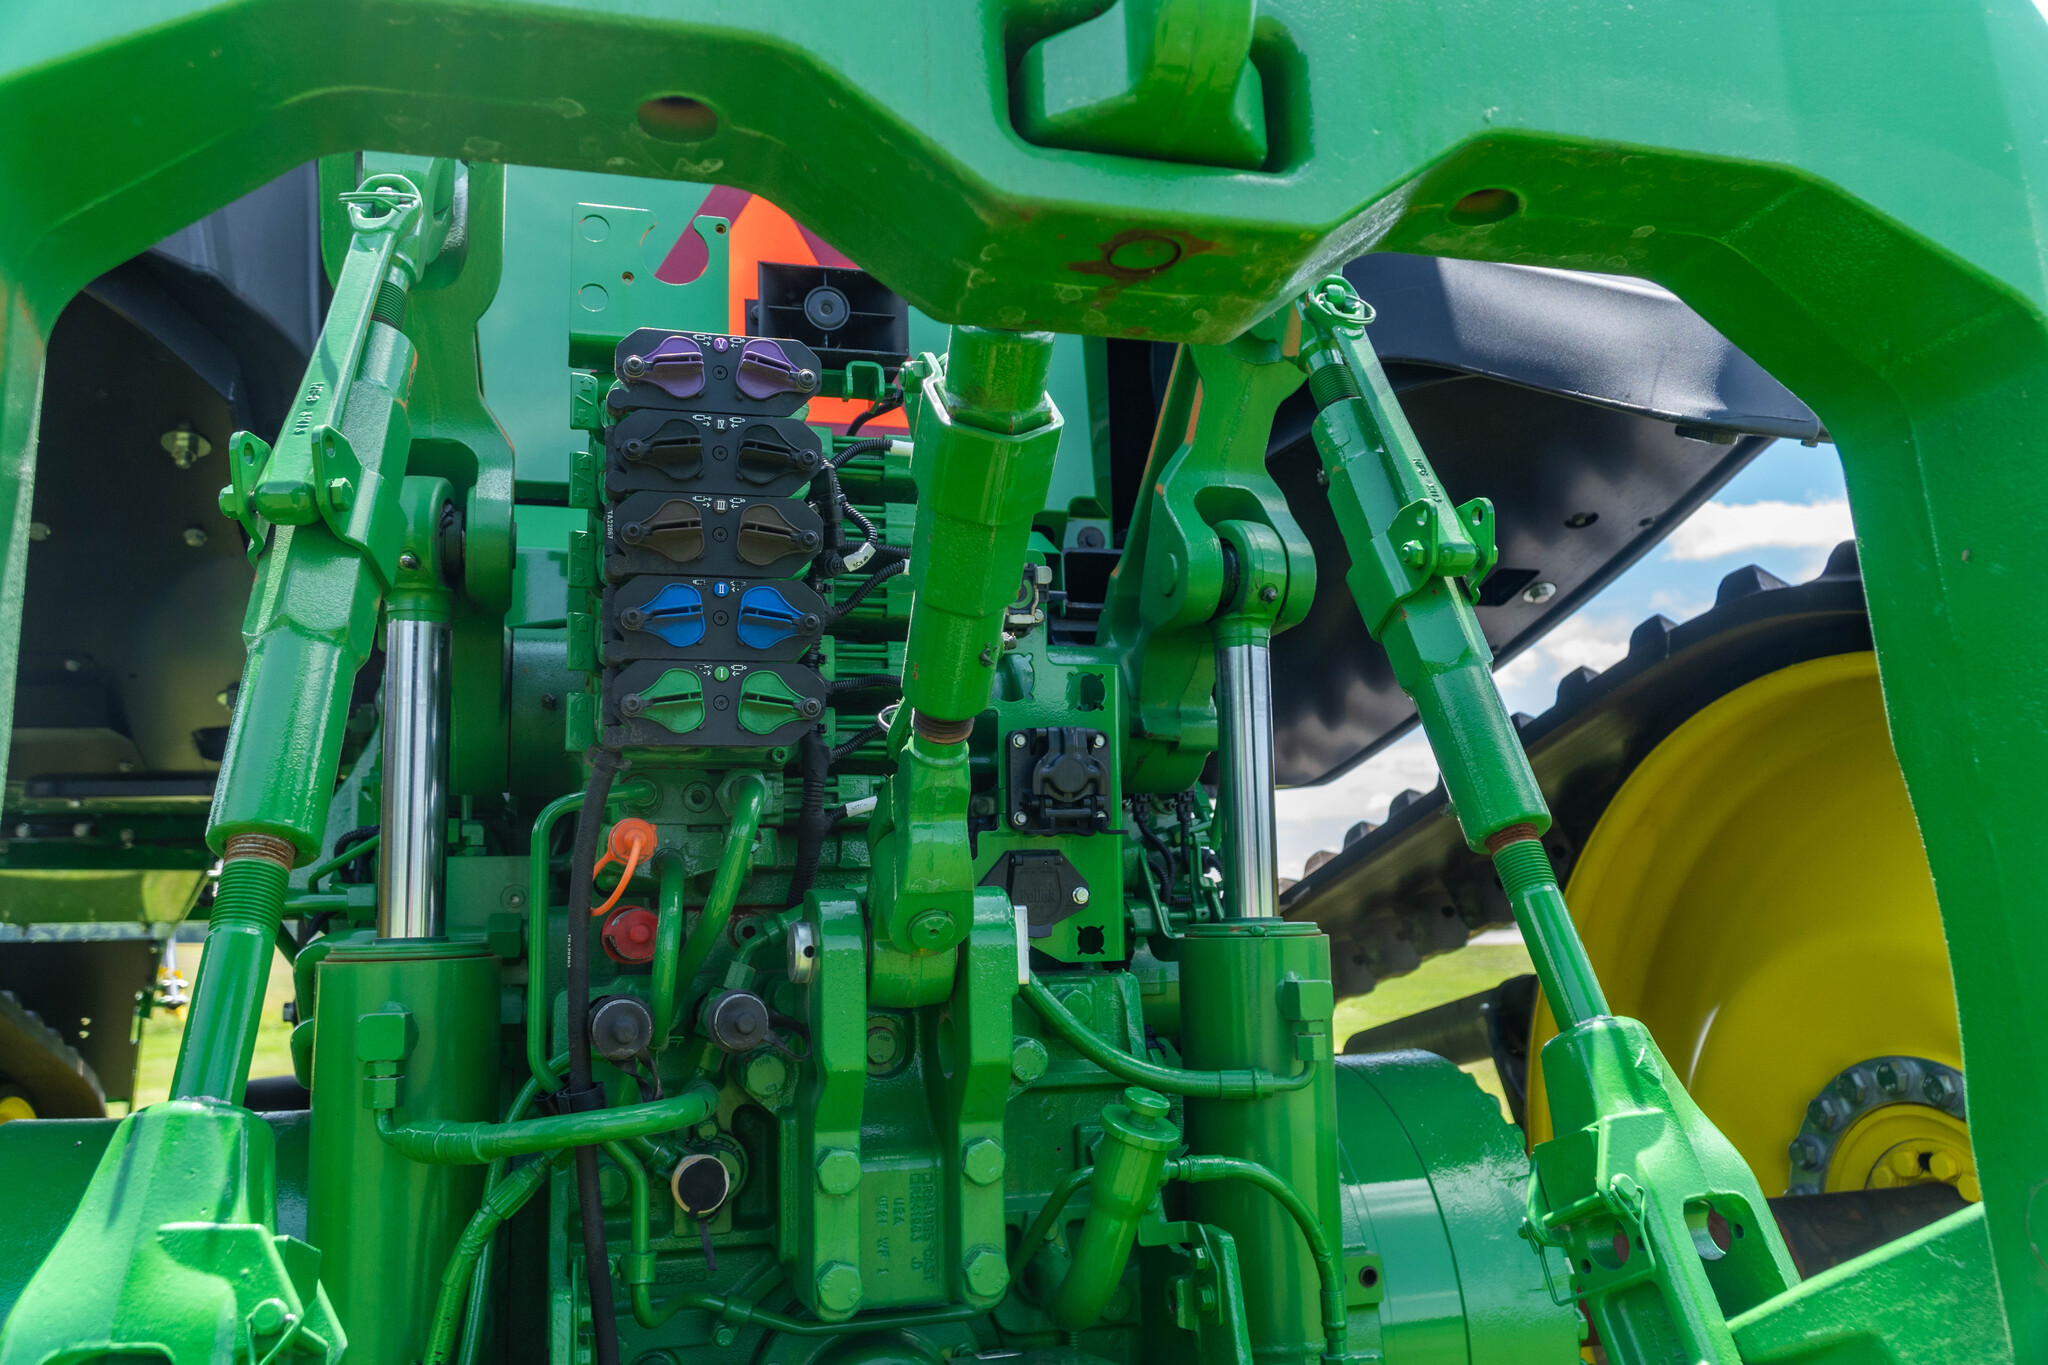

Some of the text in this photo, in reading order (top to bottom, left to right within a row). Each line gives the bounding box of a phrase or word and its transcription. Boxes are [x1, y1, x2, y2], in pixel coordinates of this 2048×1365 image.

[717, 339, 725, 349] V
[717, 419, 726, 430] IV
[717, 500, 726, 510] III
[718, 583, 726, 593] II
[894, 1197, 905, 1227] USA
